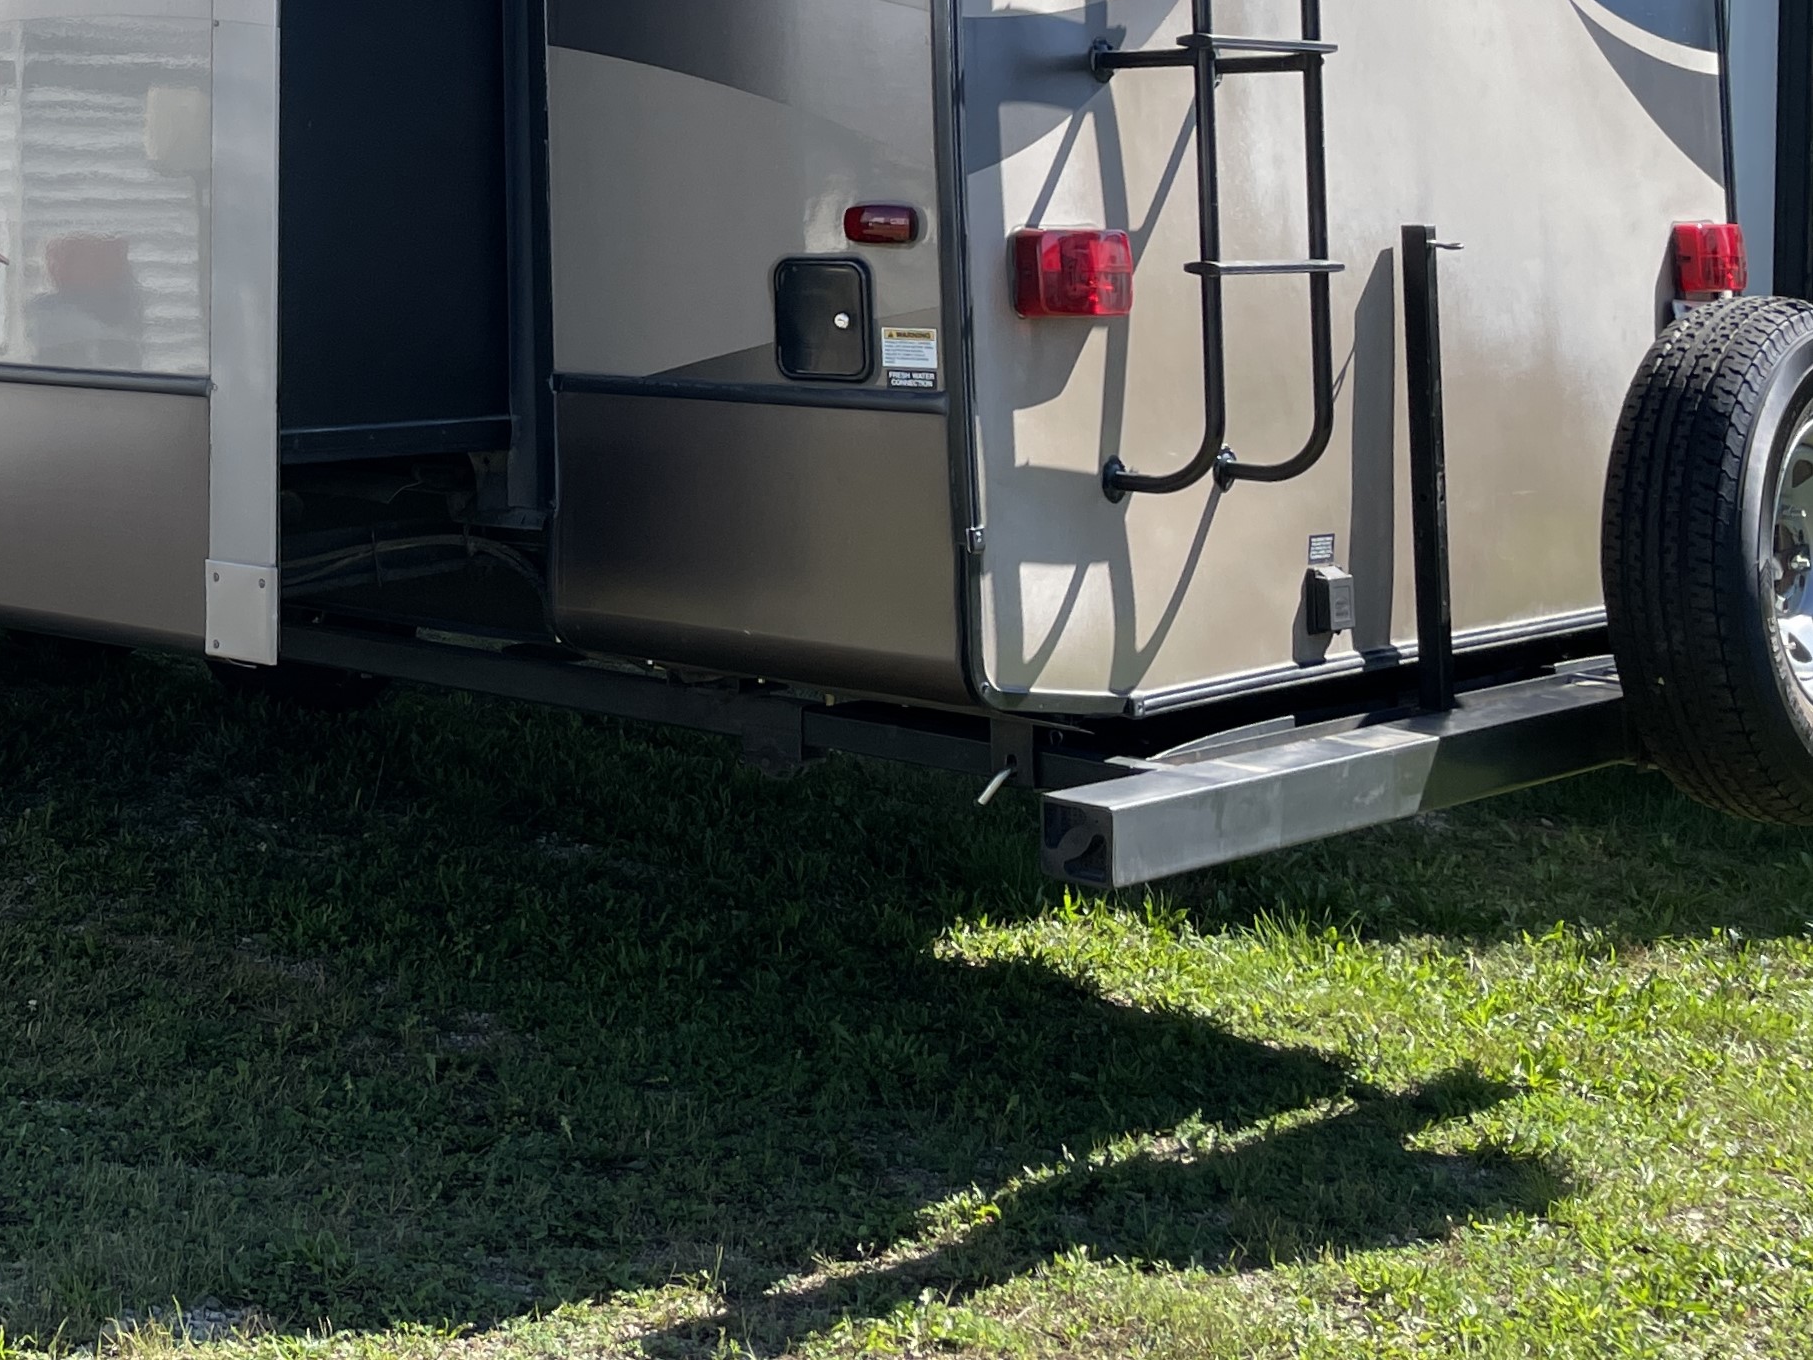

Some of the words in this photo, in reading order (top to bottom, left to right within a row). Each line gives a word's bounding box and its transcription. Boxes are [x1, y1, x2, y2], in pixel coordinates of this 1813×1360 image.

[896, 331, 931, 339] WARNING
[888, 371, 911, 379] FRESH
[912, 372, 935, 380] WATER
[890, 379, 933, 387] CONNECTION
